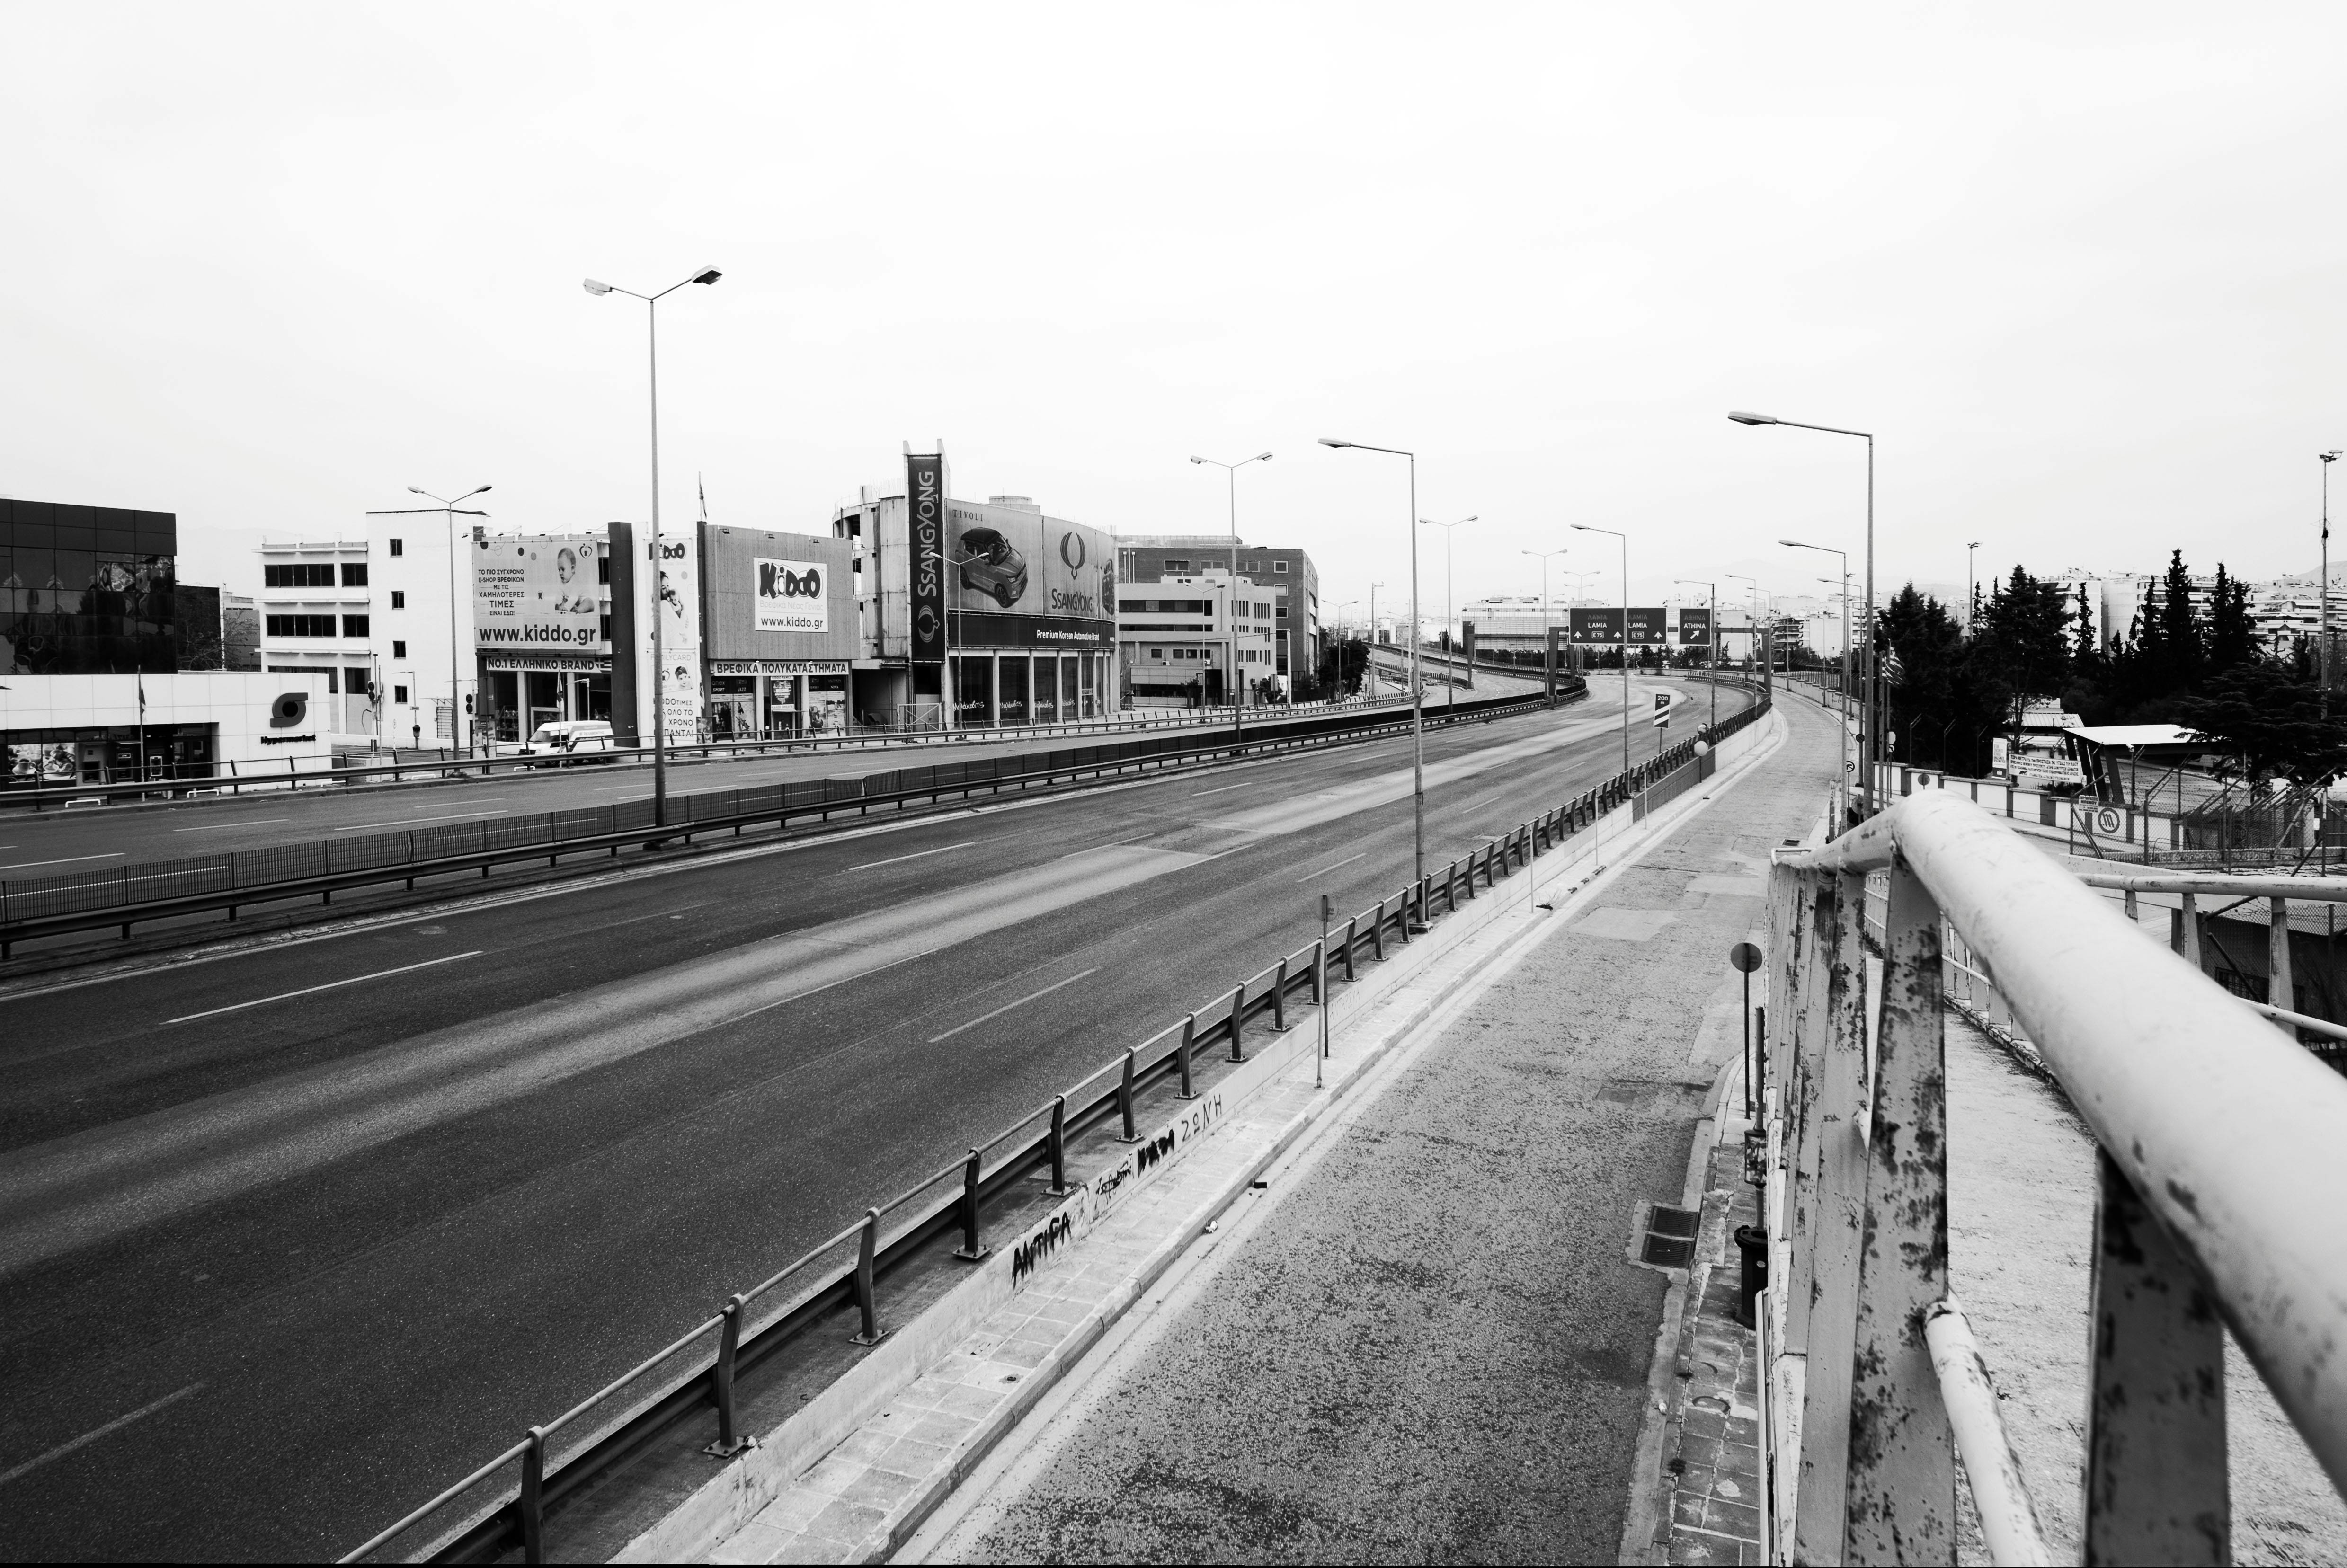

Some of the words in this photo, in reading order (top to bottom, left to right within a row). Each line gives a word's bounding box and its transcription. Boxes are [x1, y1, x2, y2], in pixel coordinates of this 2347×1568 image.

[953, 509, 983, 521] TIVOLI
[761, 616, 823, 629] www.kiddo.gr
[479, 624, 596, 646] www.kiddo.gr
[1037, 629, 1058, 639] Premium
[1059, 630, 1073, 640] Korean
[1074, 631, 1092, 640] Automotive
[489, 658, 507, 668] NO.1
[510, 659, 559, 670] ΕΛΛΗΝΙΚΟ
[561, 660, 595, 670] BRAND
[717, 663, 758, 673] ΒΡΕΦΙΚΑ
[762, 663, 846, 673] ΠΟΛΥΚΑΤΑΣΤΗΜΑΤΑ
[260, 735, 316, 745] Hypermarket
[1011, 1211, 1072, 1291] ANTIFA
